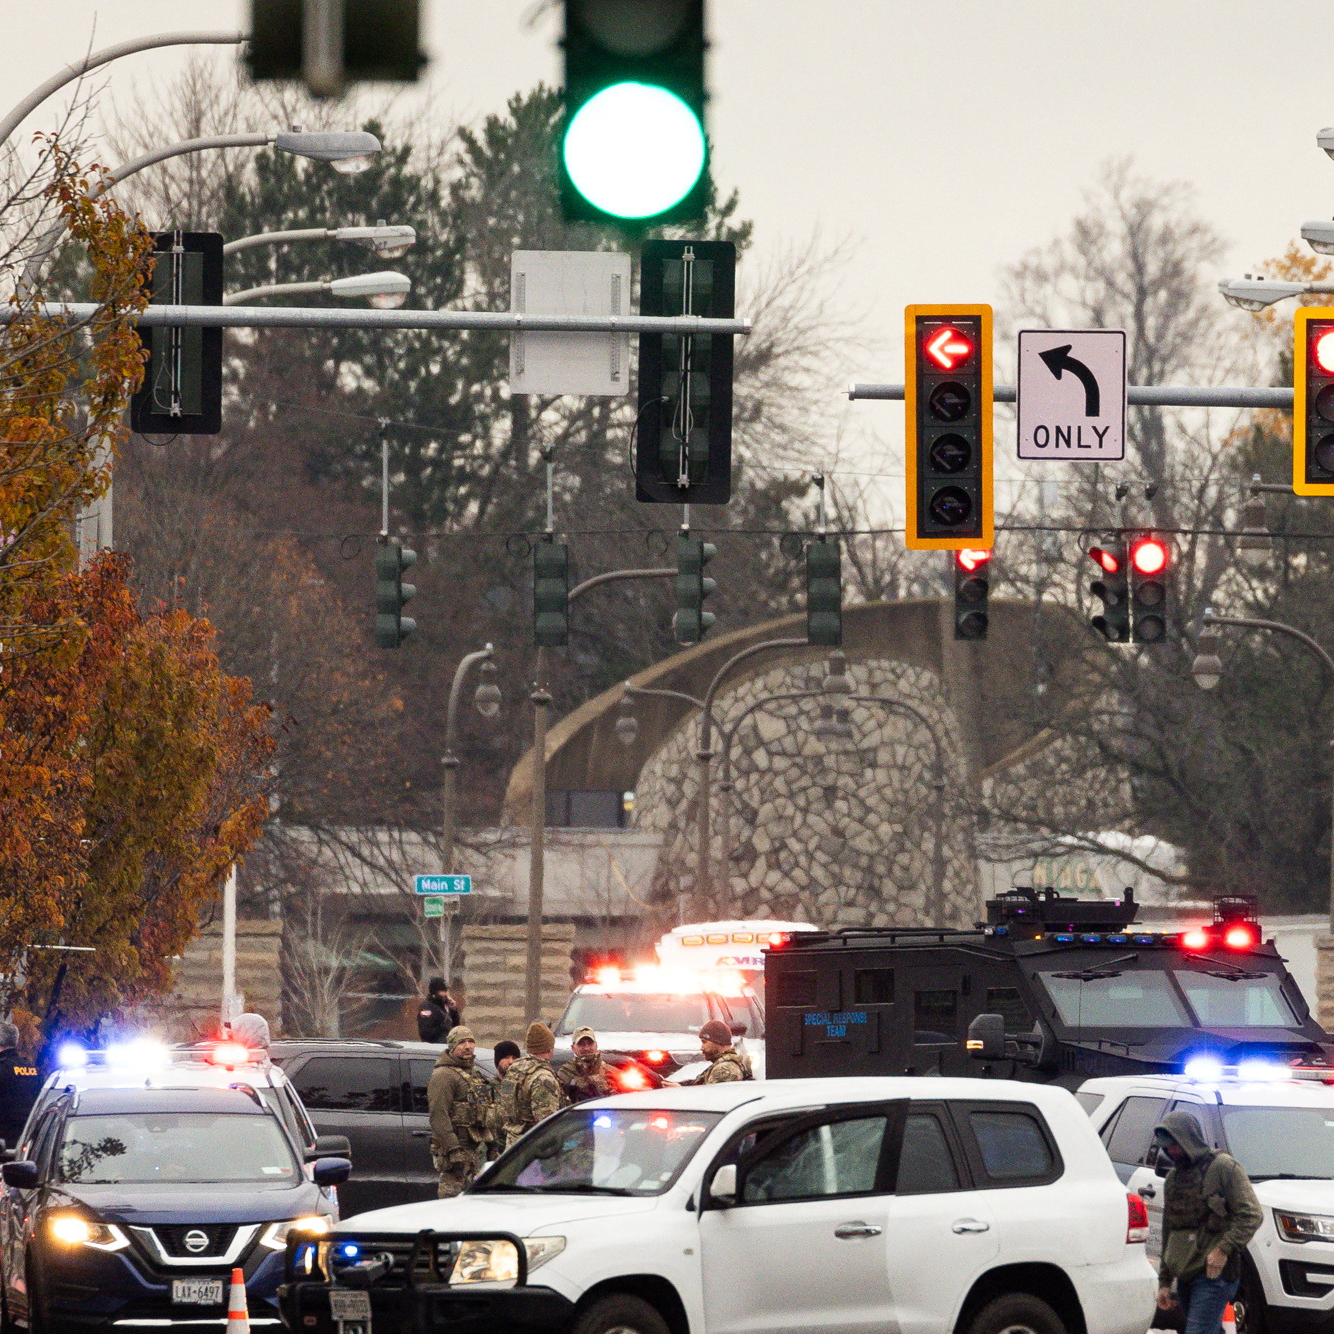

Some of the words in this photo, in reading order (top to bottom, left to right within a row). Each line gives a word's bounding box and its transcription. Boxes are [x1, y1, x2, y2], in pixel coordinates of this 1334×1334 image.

[1033, 425, 1110, 448] ONLY
[421, 879, 448, 890] Main
[453, 879, 465, 890] St
[826, 1025, 846, 1037] TEAM
[14, 1066, 37, 1076] POLICE
